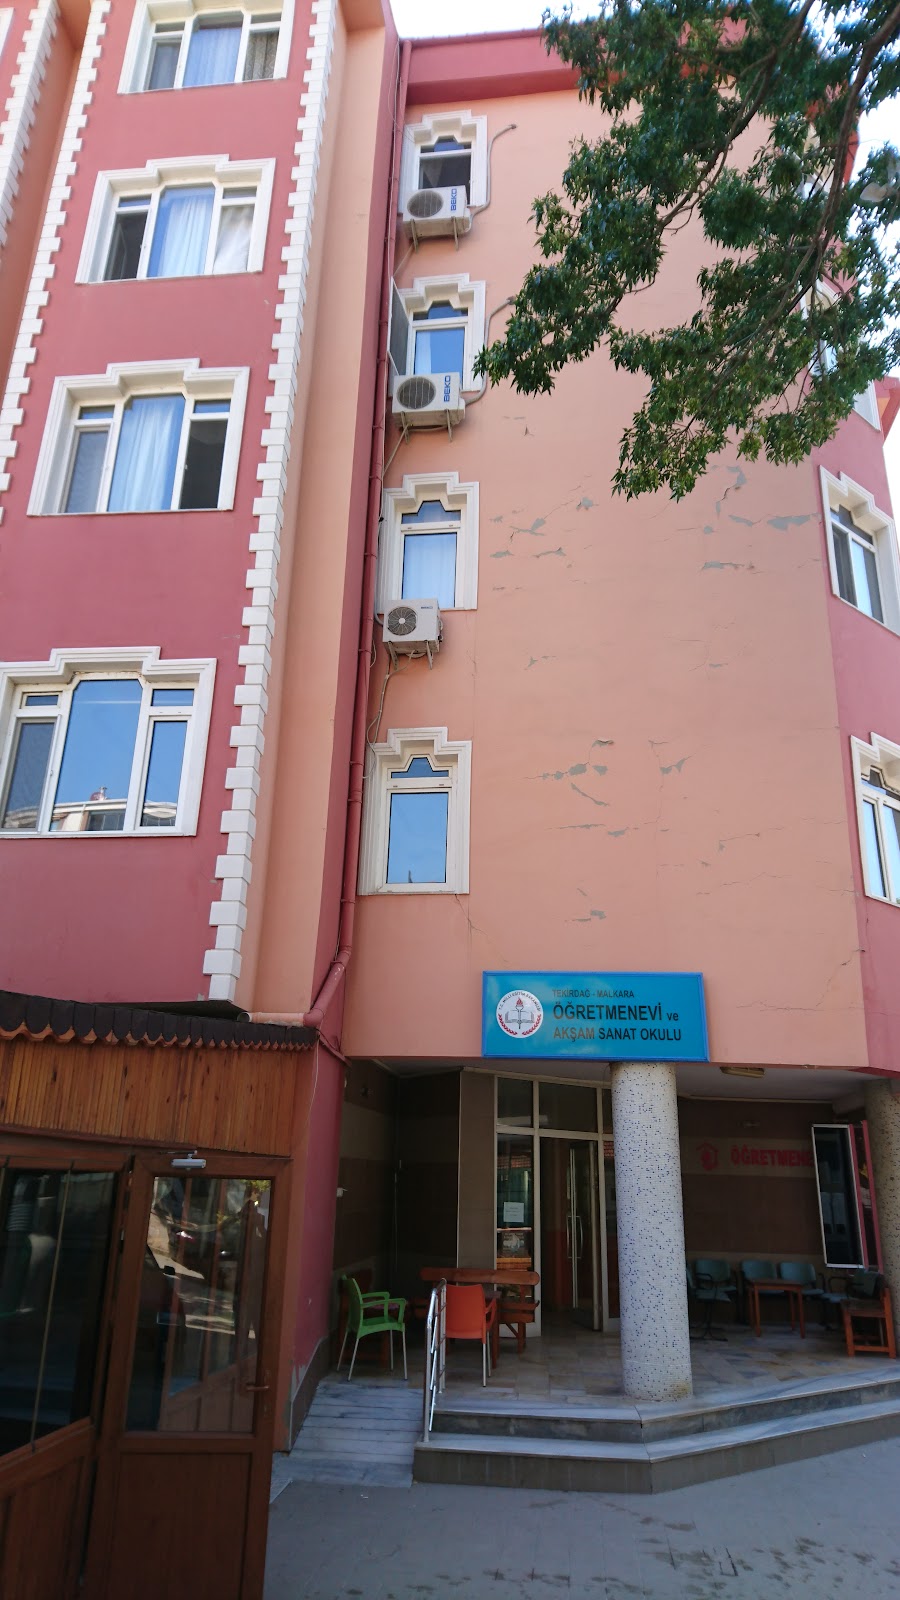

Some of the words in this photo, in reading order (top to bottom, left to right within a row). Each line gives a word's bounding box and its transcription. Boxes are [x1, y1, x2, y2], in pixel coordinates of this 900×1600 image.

[443, 375, 451, 402] BEKO
[552, 988, 590, 998] TEKİRDAĞ
[597, 989, 635, 998] MALKARA
[553, 1001, 662, 1021] ÖĞRETMENEVİ
[666, 1012, 679, 1021] ve
[553, 1027, 595, 1042] AKŞAM
[598, 1027, 637, 1040] SANAT
[640, 1028, 682, 1041] OKULU
